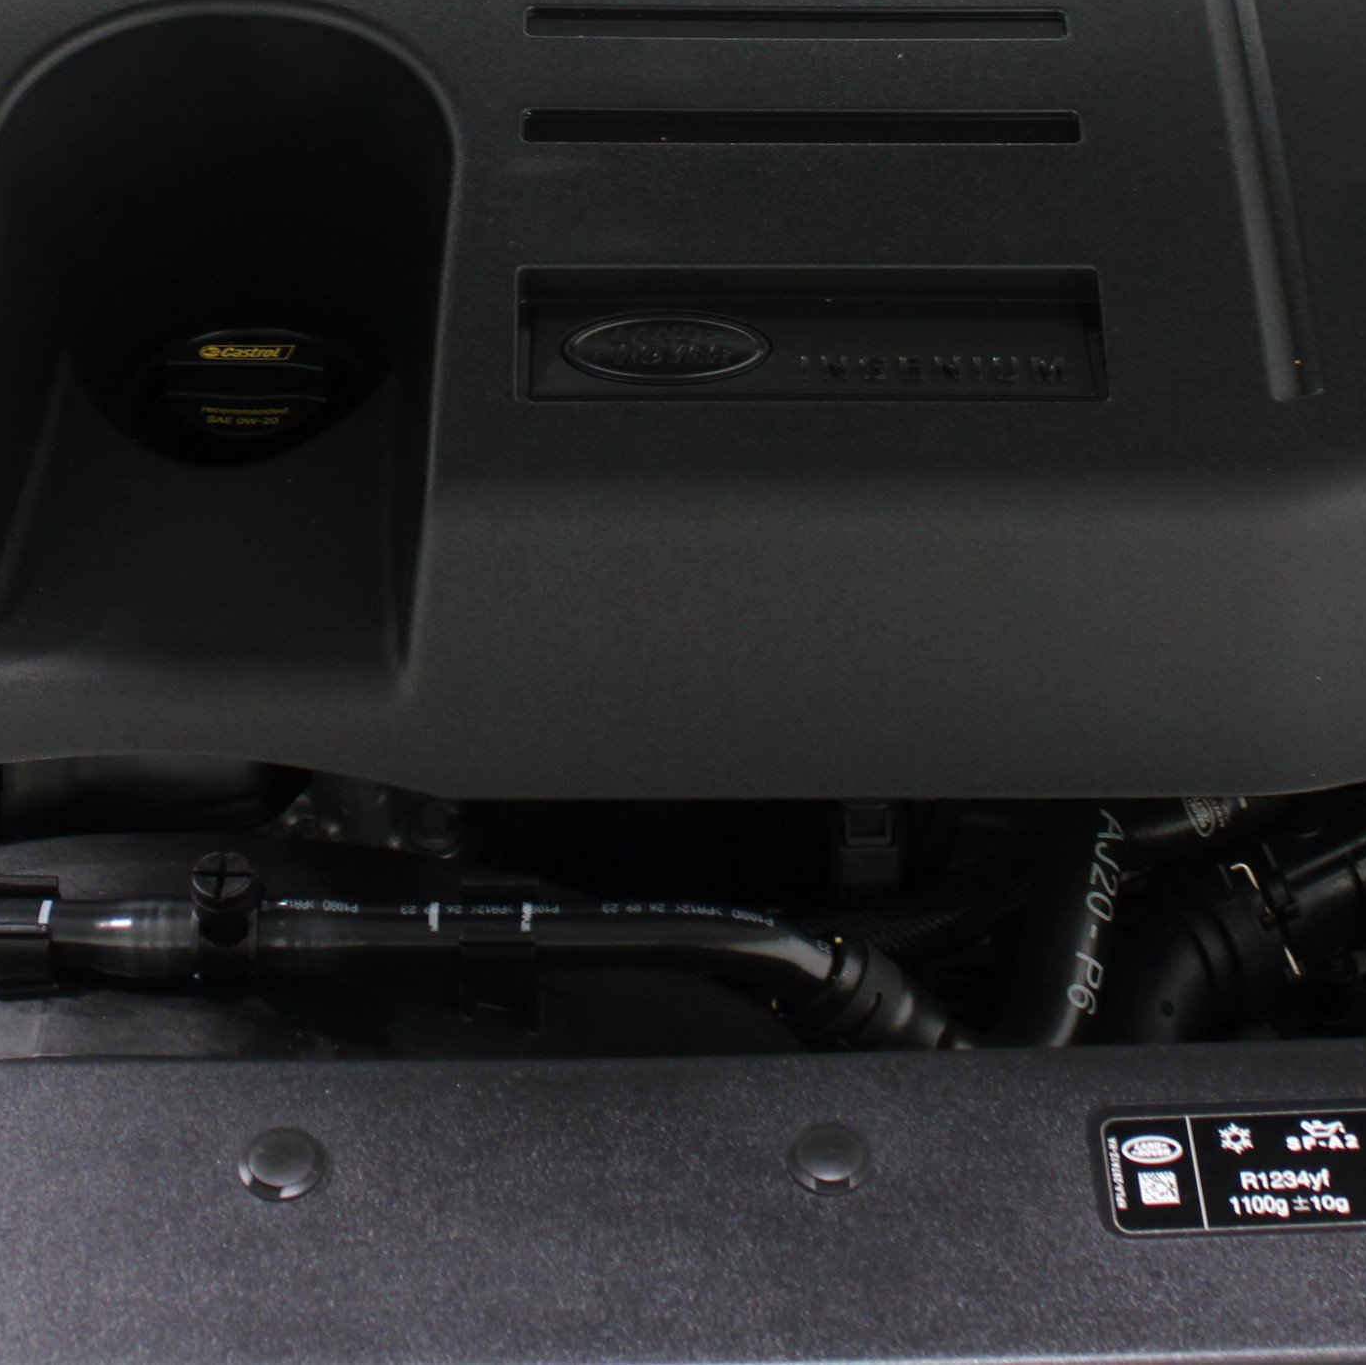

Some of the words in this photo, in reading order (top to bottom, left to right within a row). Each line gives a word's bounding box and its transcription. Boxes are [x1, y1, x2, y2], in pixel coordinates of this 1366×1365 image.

[220, 346, 282, 359] Castrol
[799, 354, 1067, 384] INGENIUM
[206, 415, 232, 426] SAE
[1285, 1133, 1360, 1152] SP-A2
[1239, 1167, 1331, 1192] R1234yf
[1229, 1194, 1291, 1218] 1100g
